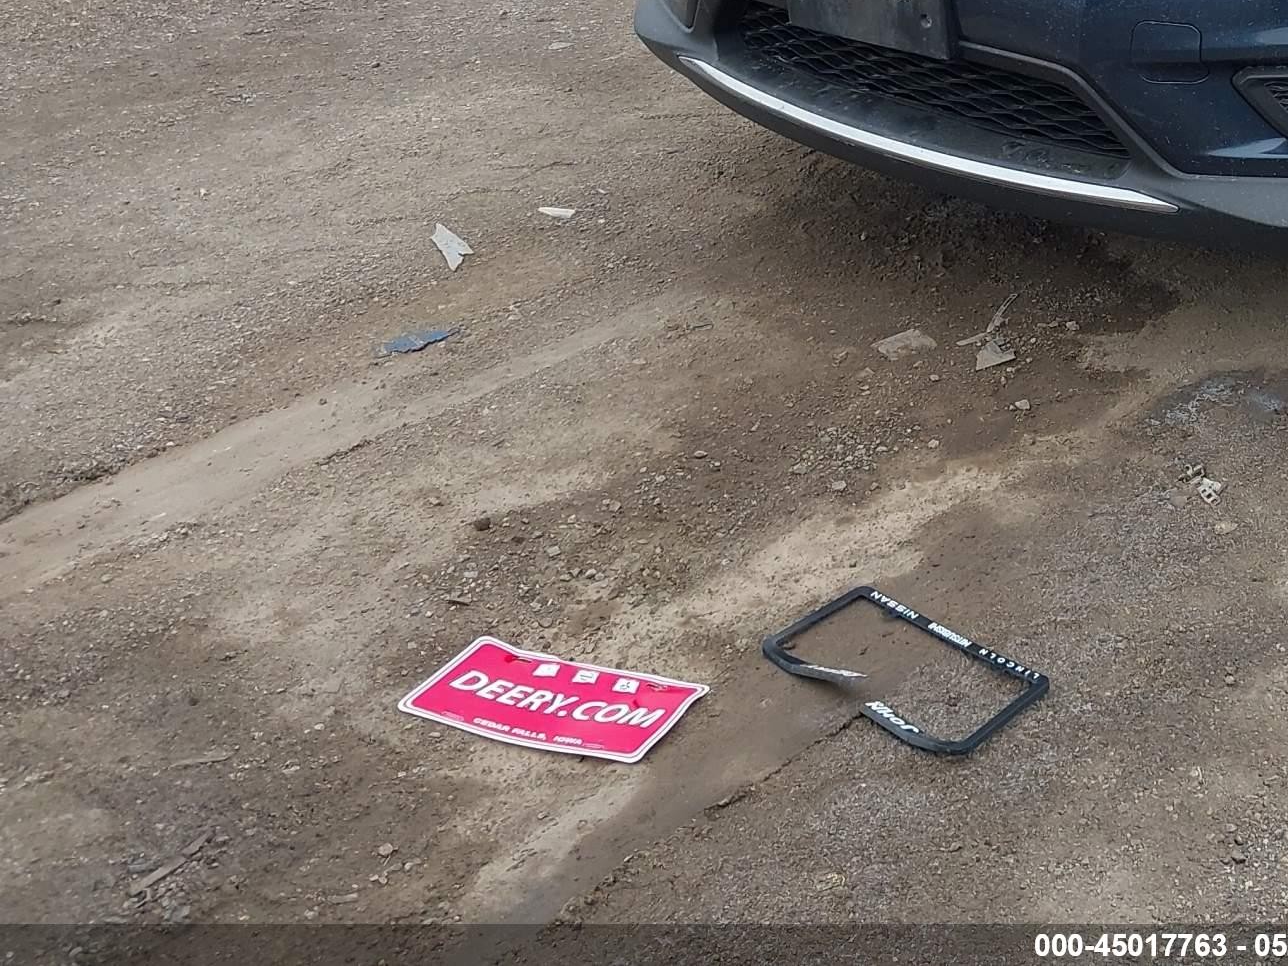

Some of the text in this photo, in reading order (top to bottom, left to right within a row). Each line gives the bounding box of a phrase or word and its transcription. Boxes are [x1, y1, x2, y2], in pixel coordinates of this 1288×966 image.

[870, 590, 920, 620] NISSAN
[978, 648, 1040, 680] LINCOLN
[449, 669, 667, 729] DEERY.COM
[472, 716, 511, 733] CEDAR
[553, 734, 583, 746] IOWA
